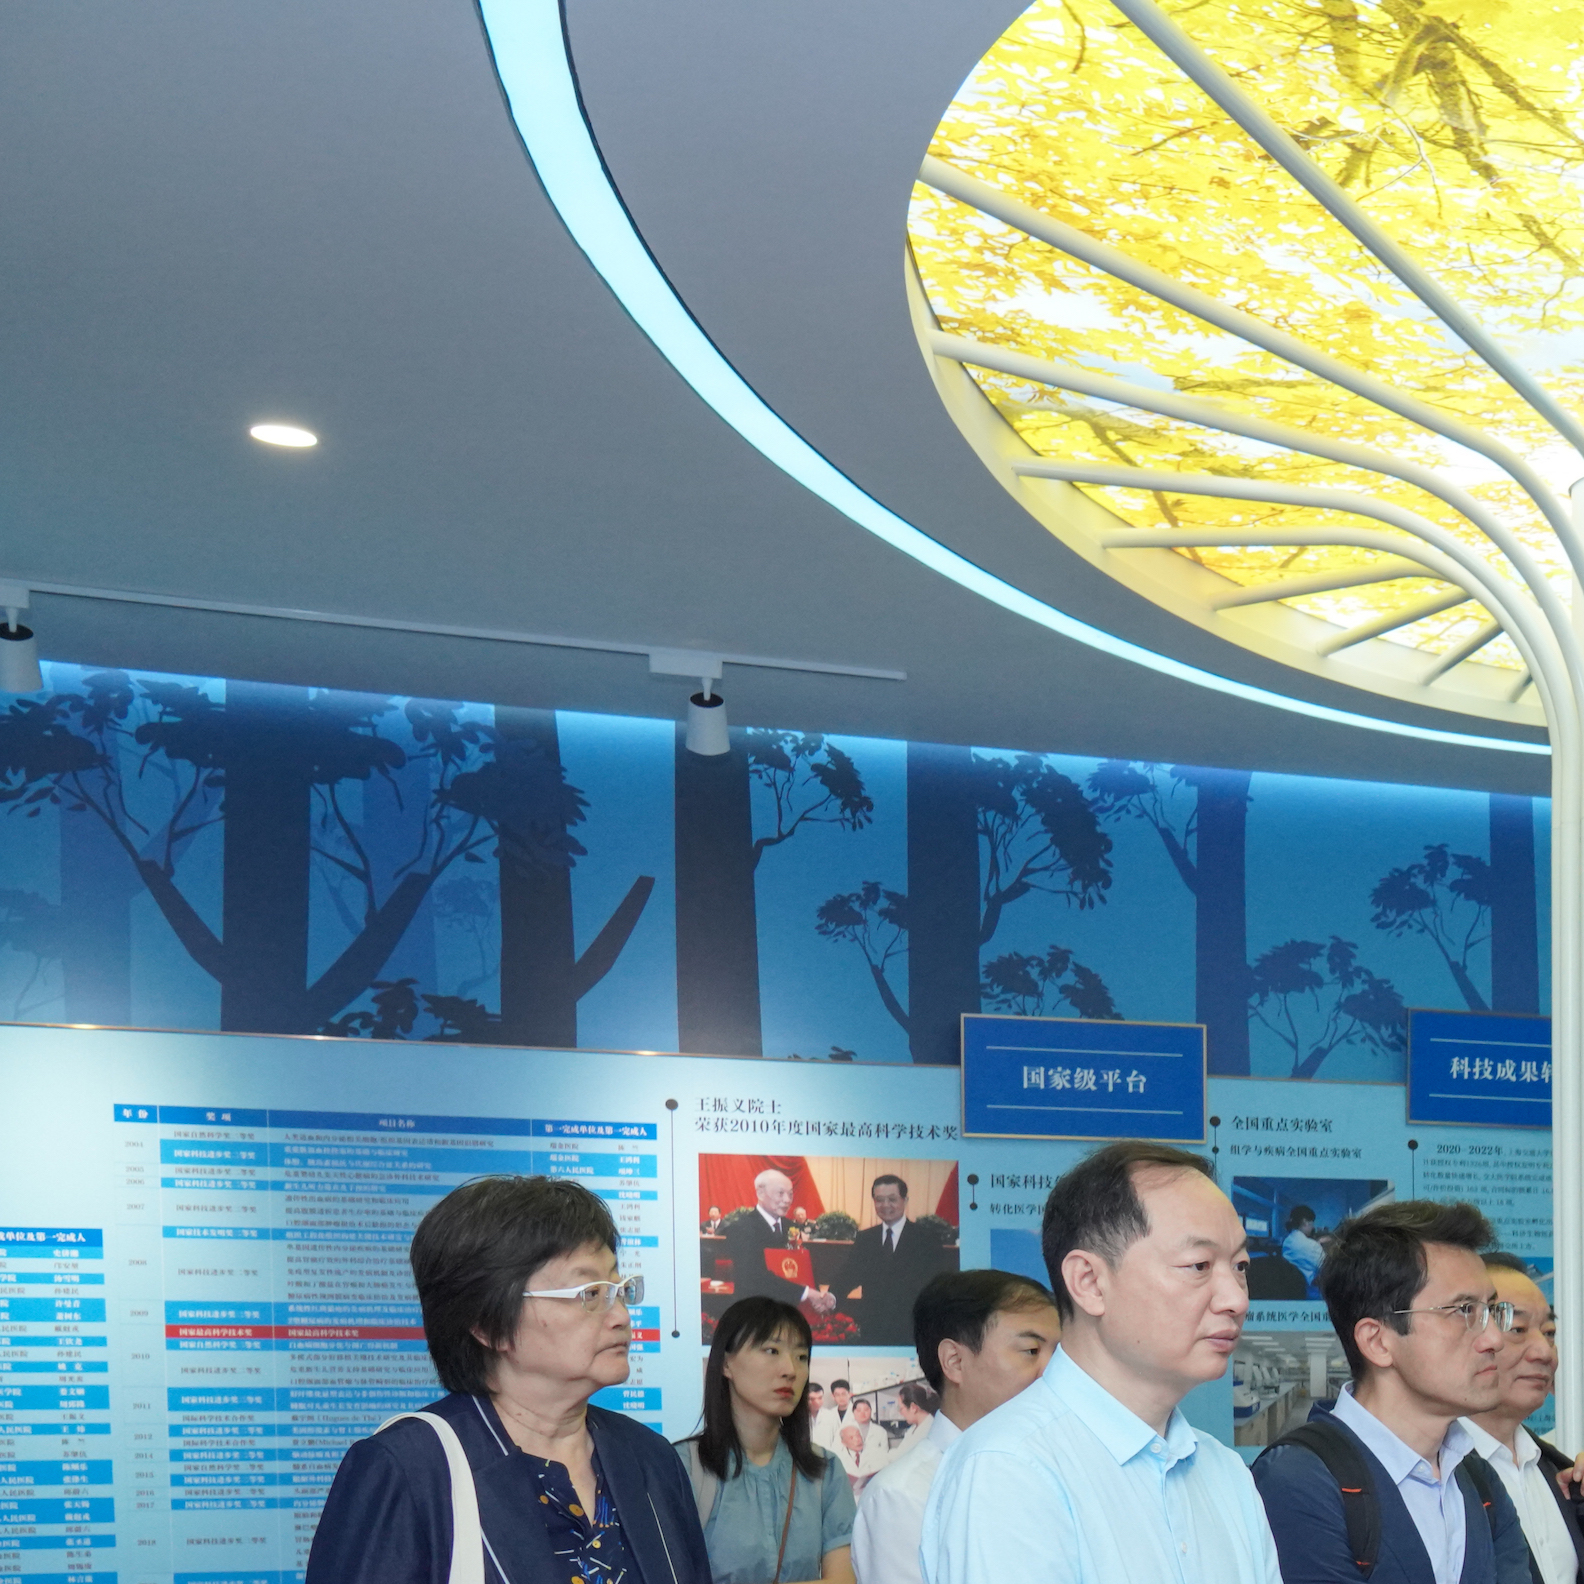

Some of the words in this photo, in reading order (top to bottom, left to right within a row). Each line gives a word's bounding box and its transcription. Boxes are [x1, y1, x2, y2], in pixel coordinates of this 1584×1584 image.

[1022, 1065, 1147, 1094] 国家级平台
[695, 1097, 782, 1114] 王振义院士
[379, 1118, 415, 1128] 项目名称
[1231, 1115, 1333, 1134] 全国重点实验室
[545, 1123, 648, 1137] 第一完成单位及第一完成人
[695, 1117, 958, 1141] 荣获2010年度国家最高科学技术奖
[173, 1130, 255, 1140] 国家自然科学奖二等奖
[124, 1140, 144, 1148] 2004
[174, 1149, 256, 1160] 国家科技进步奖二等奖
[1230, 1144, 1362, 1159] 组学与疾病全国重点实验室
[174, 1167, 256, 1177] 国家科技进步奖二等奖
[550, 1166, 594, 1175] 第六人民医院
[175, 1179, 256, 1189] 国家科技进步奖二等奖
[990, 1173, 1060, 1189] 国家科技
[176, 1203, 256, 1213] 国家科技进步奖二等奖
[176, 1227, 257, 1238] 国家技术发明奖二等奖
[177, 1267, 258, 1277] 国家科技进步奖二等奖
[179, 1309, 260, 1319] 国家科技进步奖二等奖
[179, 1327, 252, 1337] 国家最高科学技术奖
[288, 1328, 359, 1338] 国家最高科学技术奖
[179, 1340, 261, 1349] 国家自然科学奖二等奖
[181, 1366, 261, 1375] 国家科技进步奖二等奖
[181, 1395, 262, 1405] 国家科技进步奖二等奖
[182, 1414, 255, 1423] 国际科学技术合作奖
[182, 1425, 263, 1435] 国家科技进步奖二等奖
[183, 1439, 256, 1447] 国际科学技术合作奖
[183, 1451, 264, 1460] 国家科技进步奖二等奖
[184, 1463, 264, 1471] 国家自然科学奖二等奖
[184, 1475, 265, 1484] 国家科技进步奖二等奖
[185, 1487, 265, 1496] 国家科技进步奖二等奖
[185, 1499, 265, 1509] 国家科技进步奖二等奖
[187, 1536, 267, 1545] 国家科技进步奖二等奖
